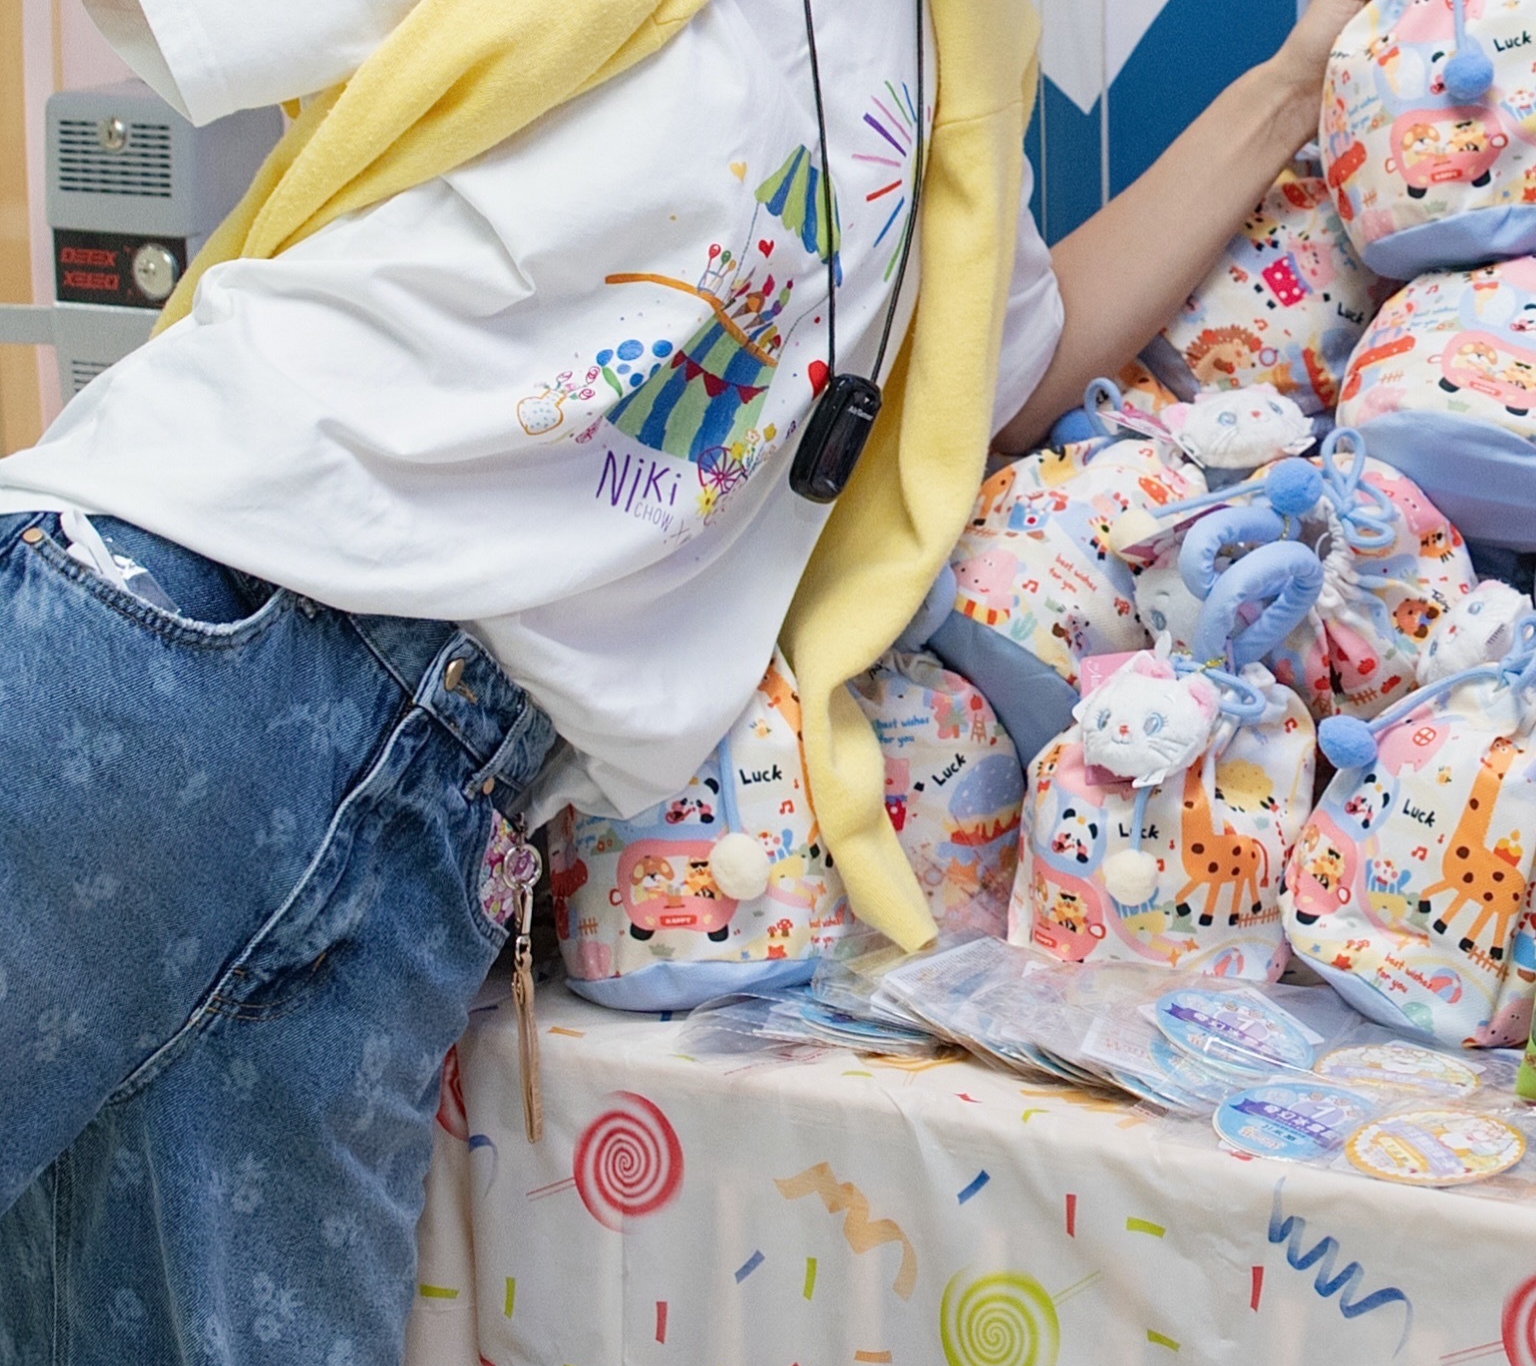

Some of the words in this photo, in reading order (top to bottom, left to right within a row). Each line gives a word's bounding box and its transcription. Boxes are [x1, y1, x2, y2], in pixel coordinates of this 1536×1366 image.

[1494, 31, 1532, 52] Luck
[1337, 303, 1365, 327] Luck
[634, 502, 673, 533] CHOW
[739, 764, 783, 785] Luck
[932, 752, 968, 788] Luck
[1402, 800, 1437, 828] Luck
[1118, 823, 1160, 840] Lck
[1384, 952, 1406, 971] best
[1404, 967, 1433, 991] wishes
[1388, 979, 1409, 994] you
